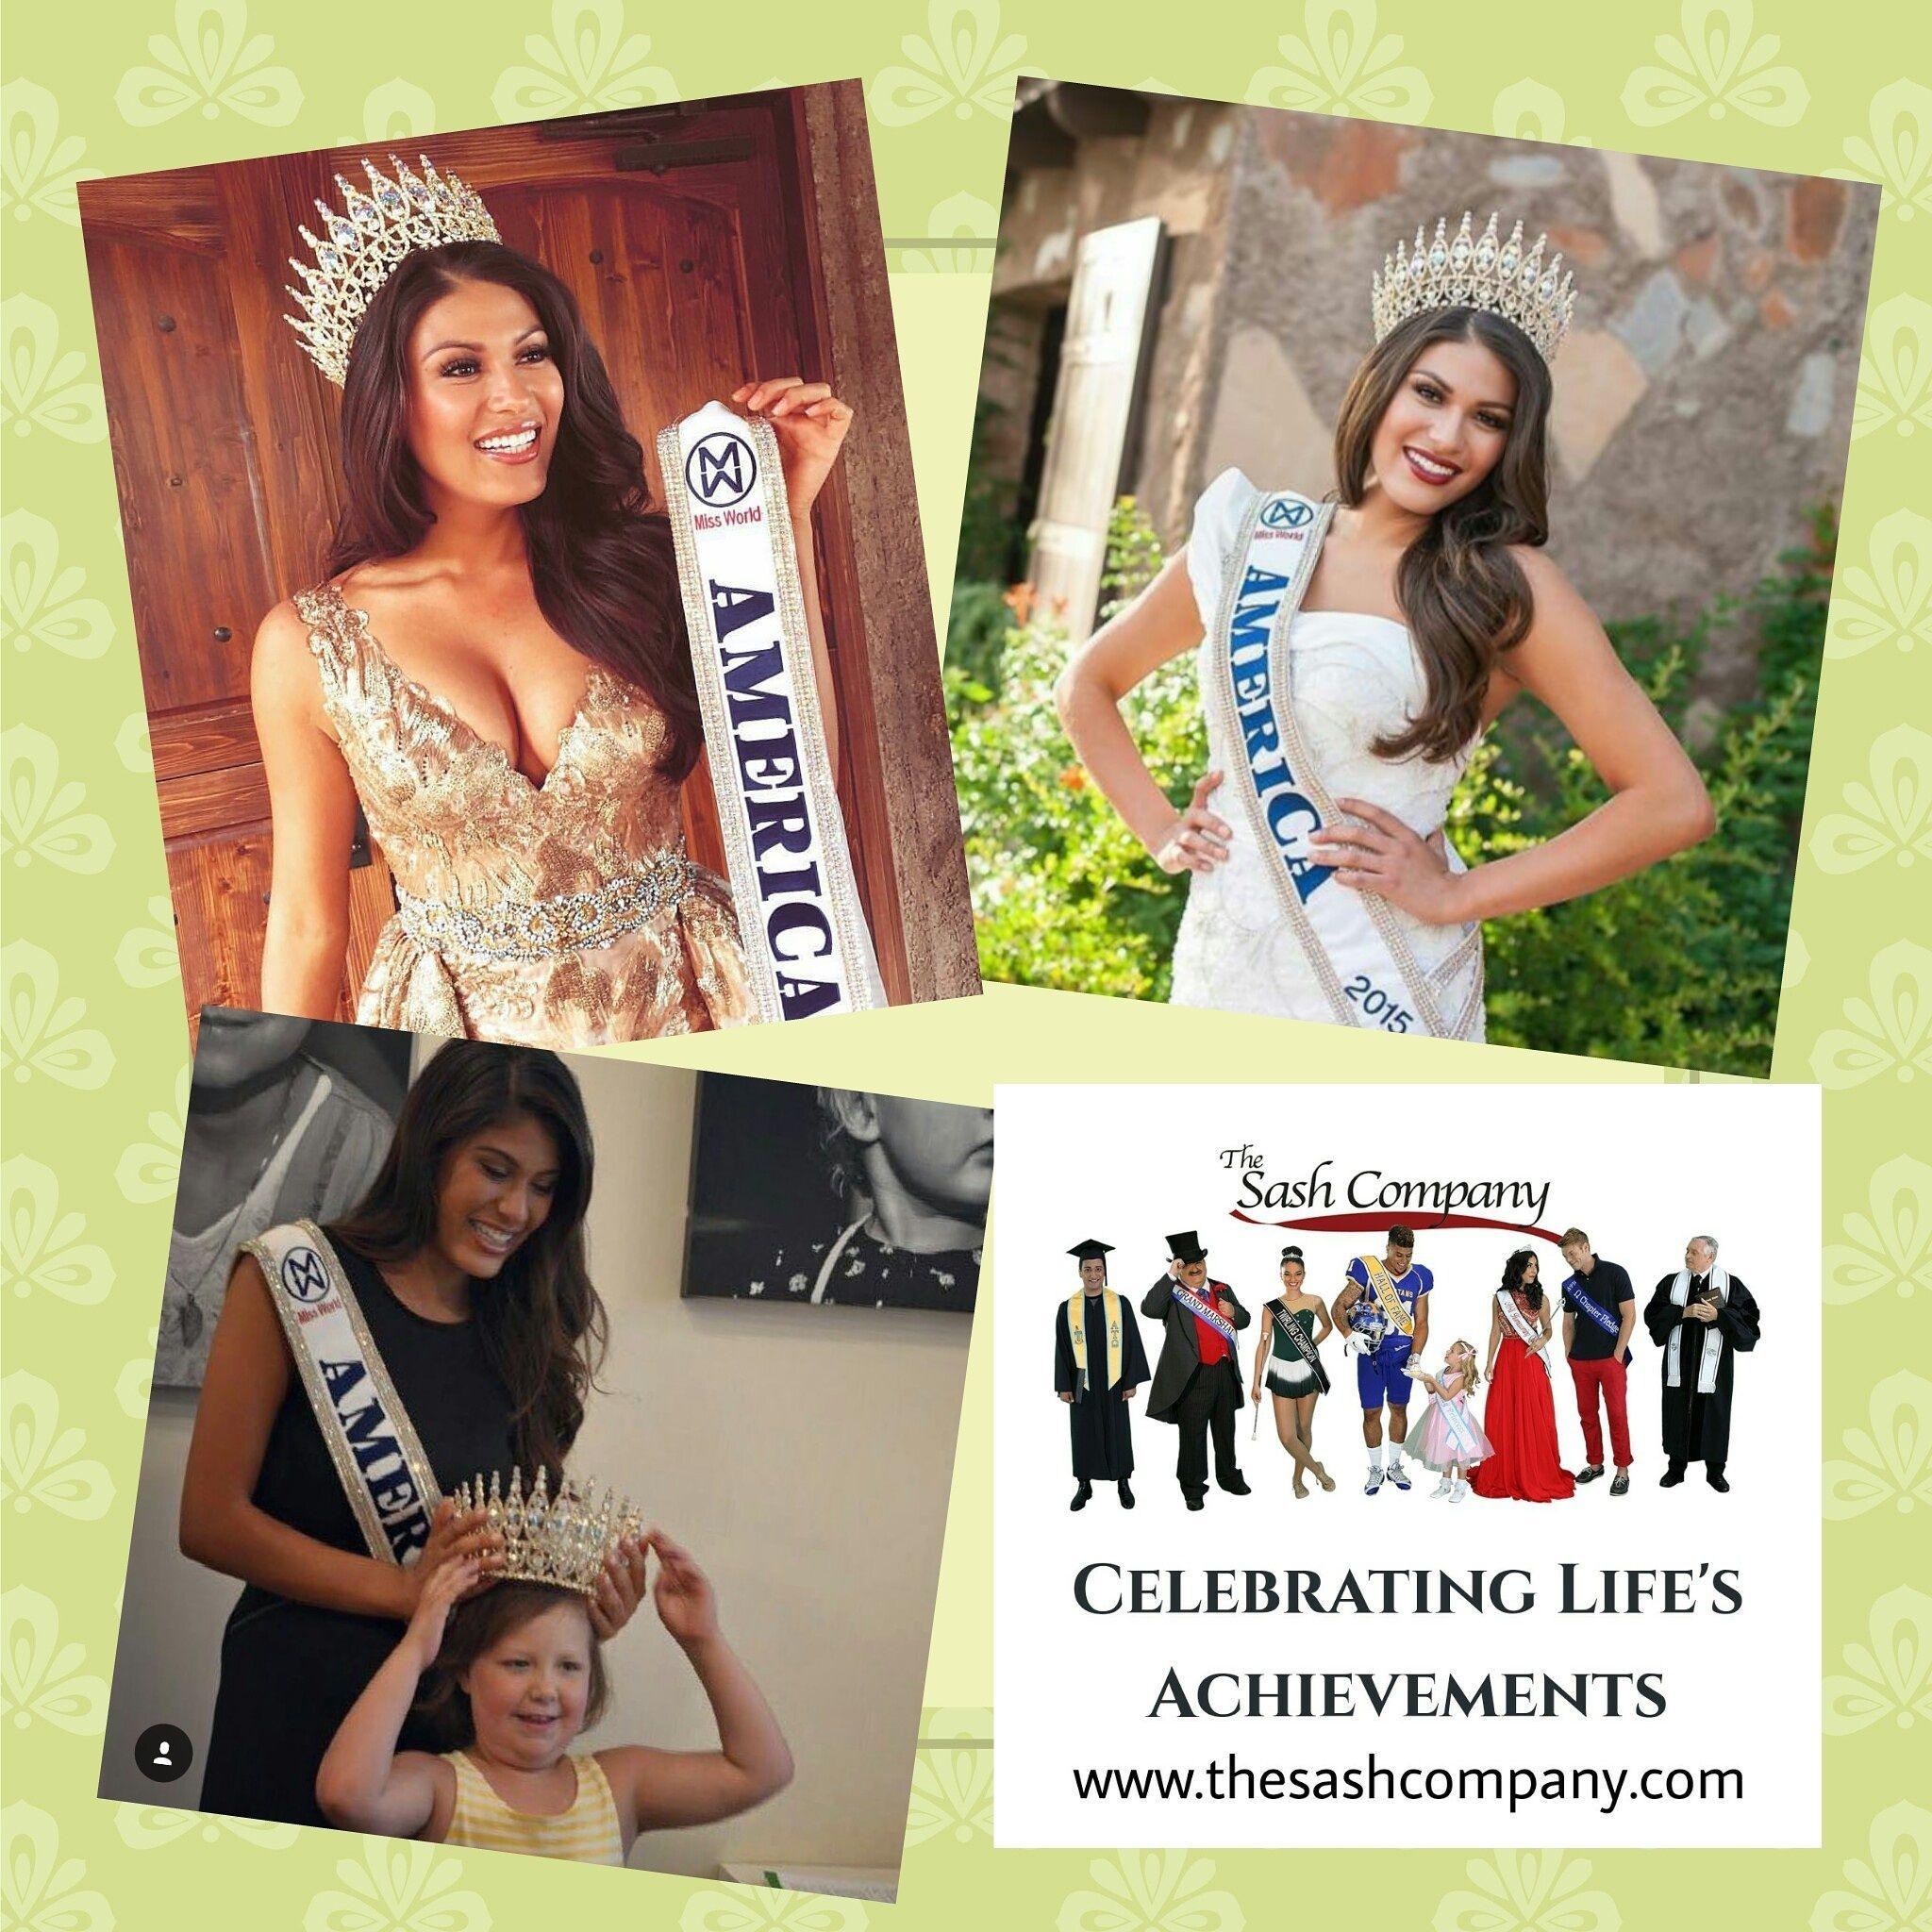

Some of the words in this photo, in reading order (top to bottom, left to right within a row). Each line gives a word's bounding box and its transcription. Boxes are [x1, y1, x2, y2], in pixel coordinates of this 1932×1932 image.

[694, 514, 722, 530] Miss
[723, 506, 762, 525] World
[1229, 565, 1340, 906] AMERICA
[708, 578, 841, 1022] AMERICA
[1342, 974, 1414, 1034] 2015
[1176, 1289, 1204, 1310] GRAND
[1201, 1308, 1235, 1336] MARSHAL
[1384, 1293, 1396, 1306] OF
[1579, 1295, 1602, 1319] Chapter
[1599, 1313, 1620, 1334] Pledge
[1276, 1308, 1300, 1337] TWIRLING
[1293, 1333, 1318, 1363] CHAMPION
